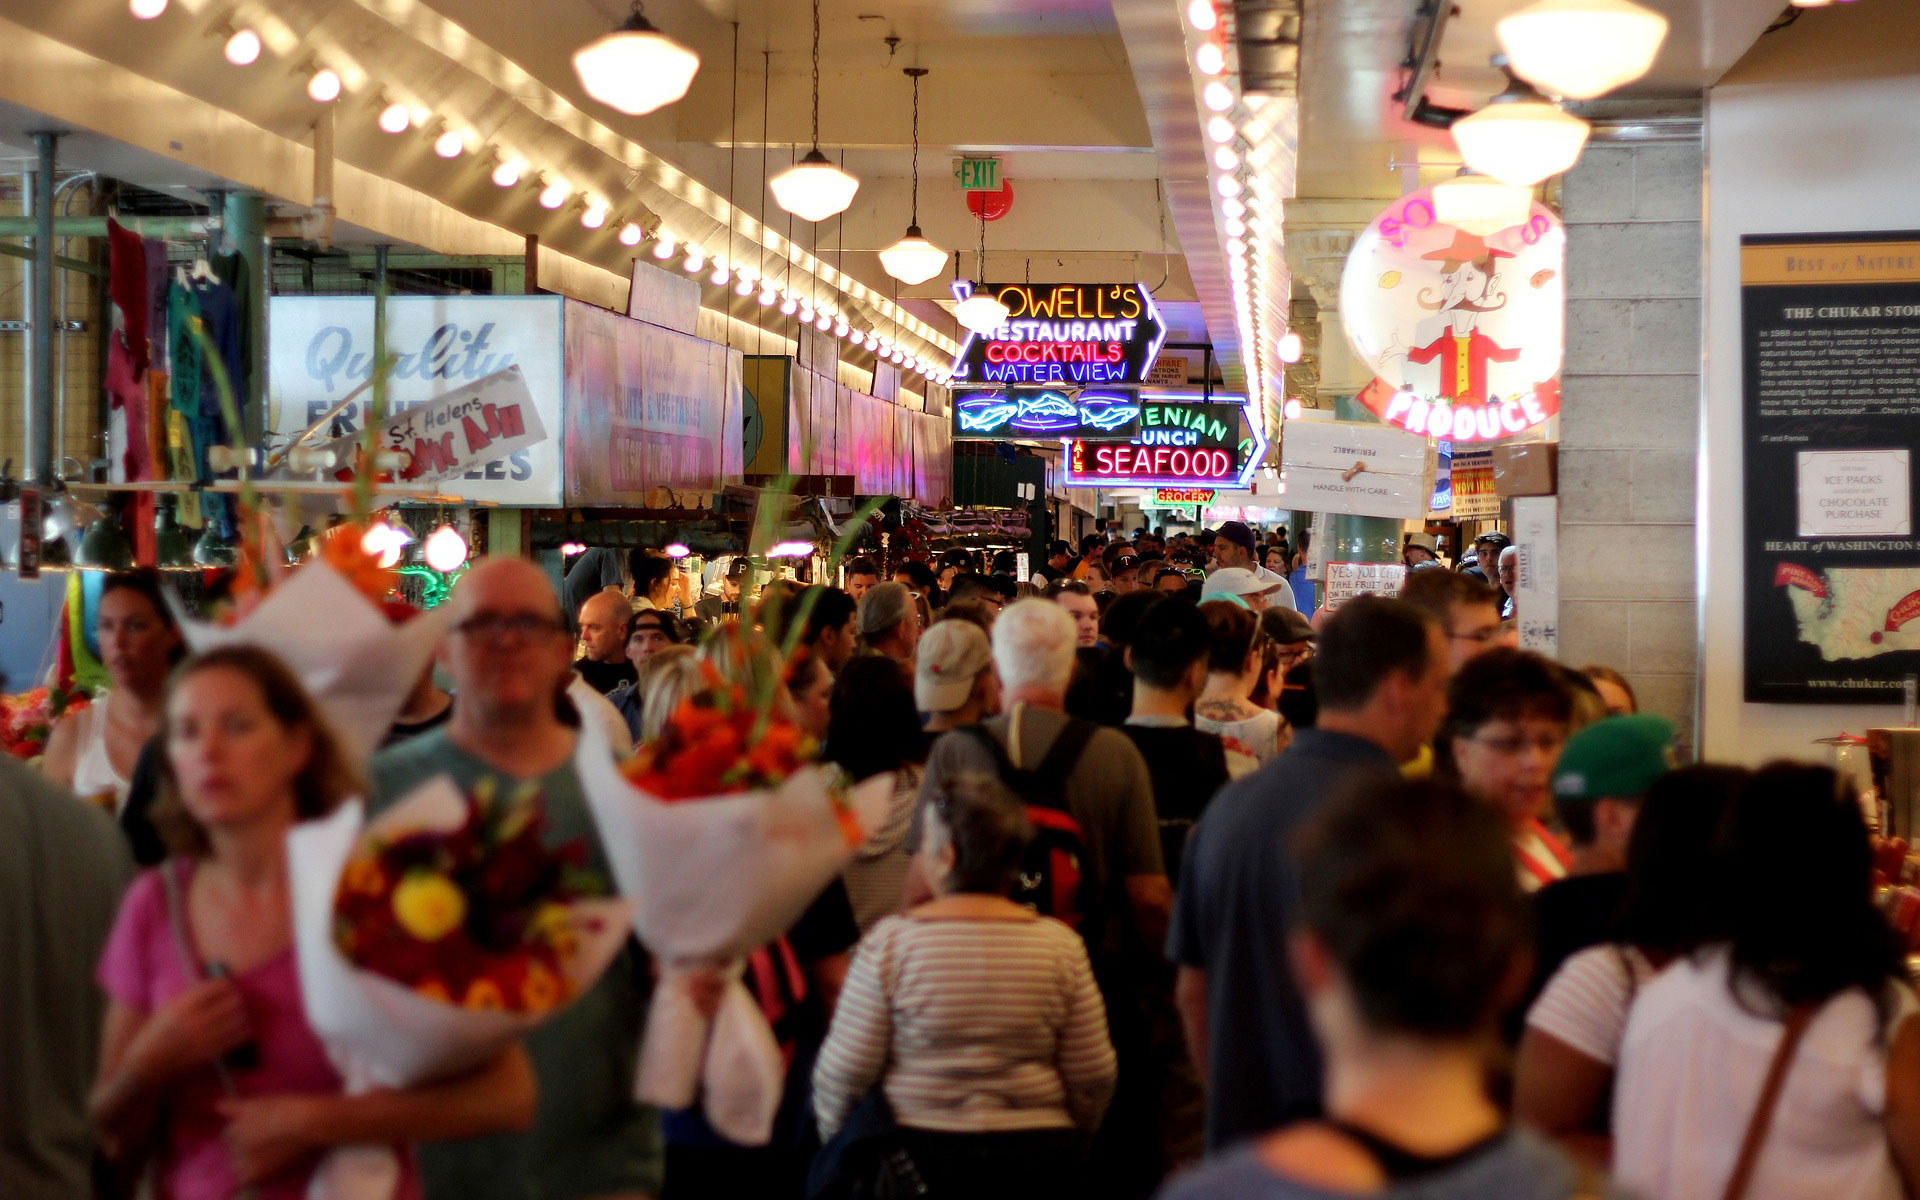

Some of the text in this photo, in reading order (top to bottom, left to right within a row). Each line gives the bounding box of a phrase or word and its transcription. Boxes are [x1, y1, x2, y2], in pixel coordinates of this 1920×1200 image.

[961, 160, 997, 188] EXIT
[1786, 256, 1825, 272] BEST
[1829, 259, 1848, 273] of
[997, 285, 1142, 319] OWELL'S
[1784, 308, 1814, 319] THE
[1818, 306, 1881, 318] CHUKAR
[1808, 329, 1832, 337] family
[986, 342, 1123, 363] COCKTAILS
[1828, 348, 1881, 356] Washington's
[1884, 347, 1900, 355] fruit
[1794, 359, 1830, 367] approach
[984, 362, 1127, 382] WATER VIEW
[1802, 369, 1849, 377] tree-ripened
[1872, 367, 1894, 375] fruits
[1778, 379, 1830, 387] extraordinary
[1832, 378, 1857, 386] cherry
[1760, 389, 1807, 397] outstanding
[1840, 398, 1889, 406] synonymous
[656, 391, 701, 429] VEGETABLES
[1385, 391, 1547, 440] PRODUCE
[1792, 408, 1811, 416] Best
[389, 395, 483, 444] St. Helens
[1139, 407, 1229, 443] ENIAN
[461, 404, 525, 455] ASH
[1096, 450, 1230, 477] SEAFOOD
[1825, 475, 1883, 485] ICE PACKS
[1313, 484, 1389, 496] HANDLE WITH CARE
[1157, 491, 1214, 503] GROCERY
[1818, 497, 1890, 508] CHOCOLATE
[1825, 509, 1884, 519] PURCHASE
[1765, 541, 1809, 551] HEART
[1812, 541, 1825, 553] of
[1825, 541, 1913, 551] WASHINGTON
[738, 563, 747, 574] P
[1519, 543, 1528, 589] SOSIO'S
[1331, 566, 1353, 579] YES
[1357, 566, 1377, 579] YOU
[1330, 581, 1353, 590] TAKE
[1355, 581, 1381, 589] FRUIT
[1342, 590, 1353, 598] THE
